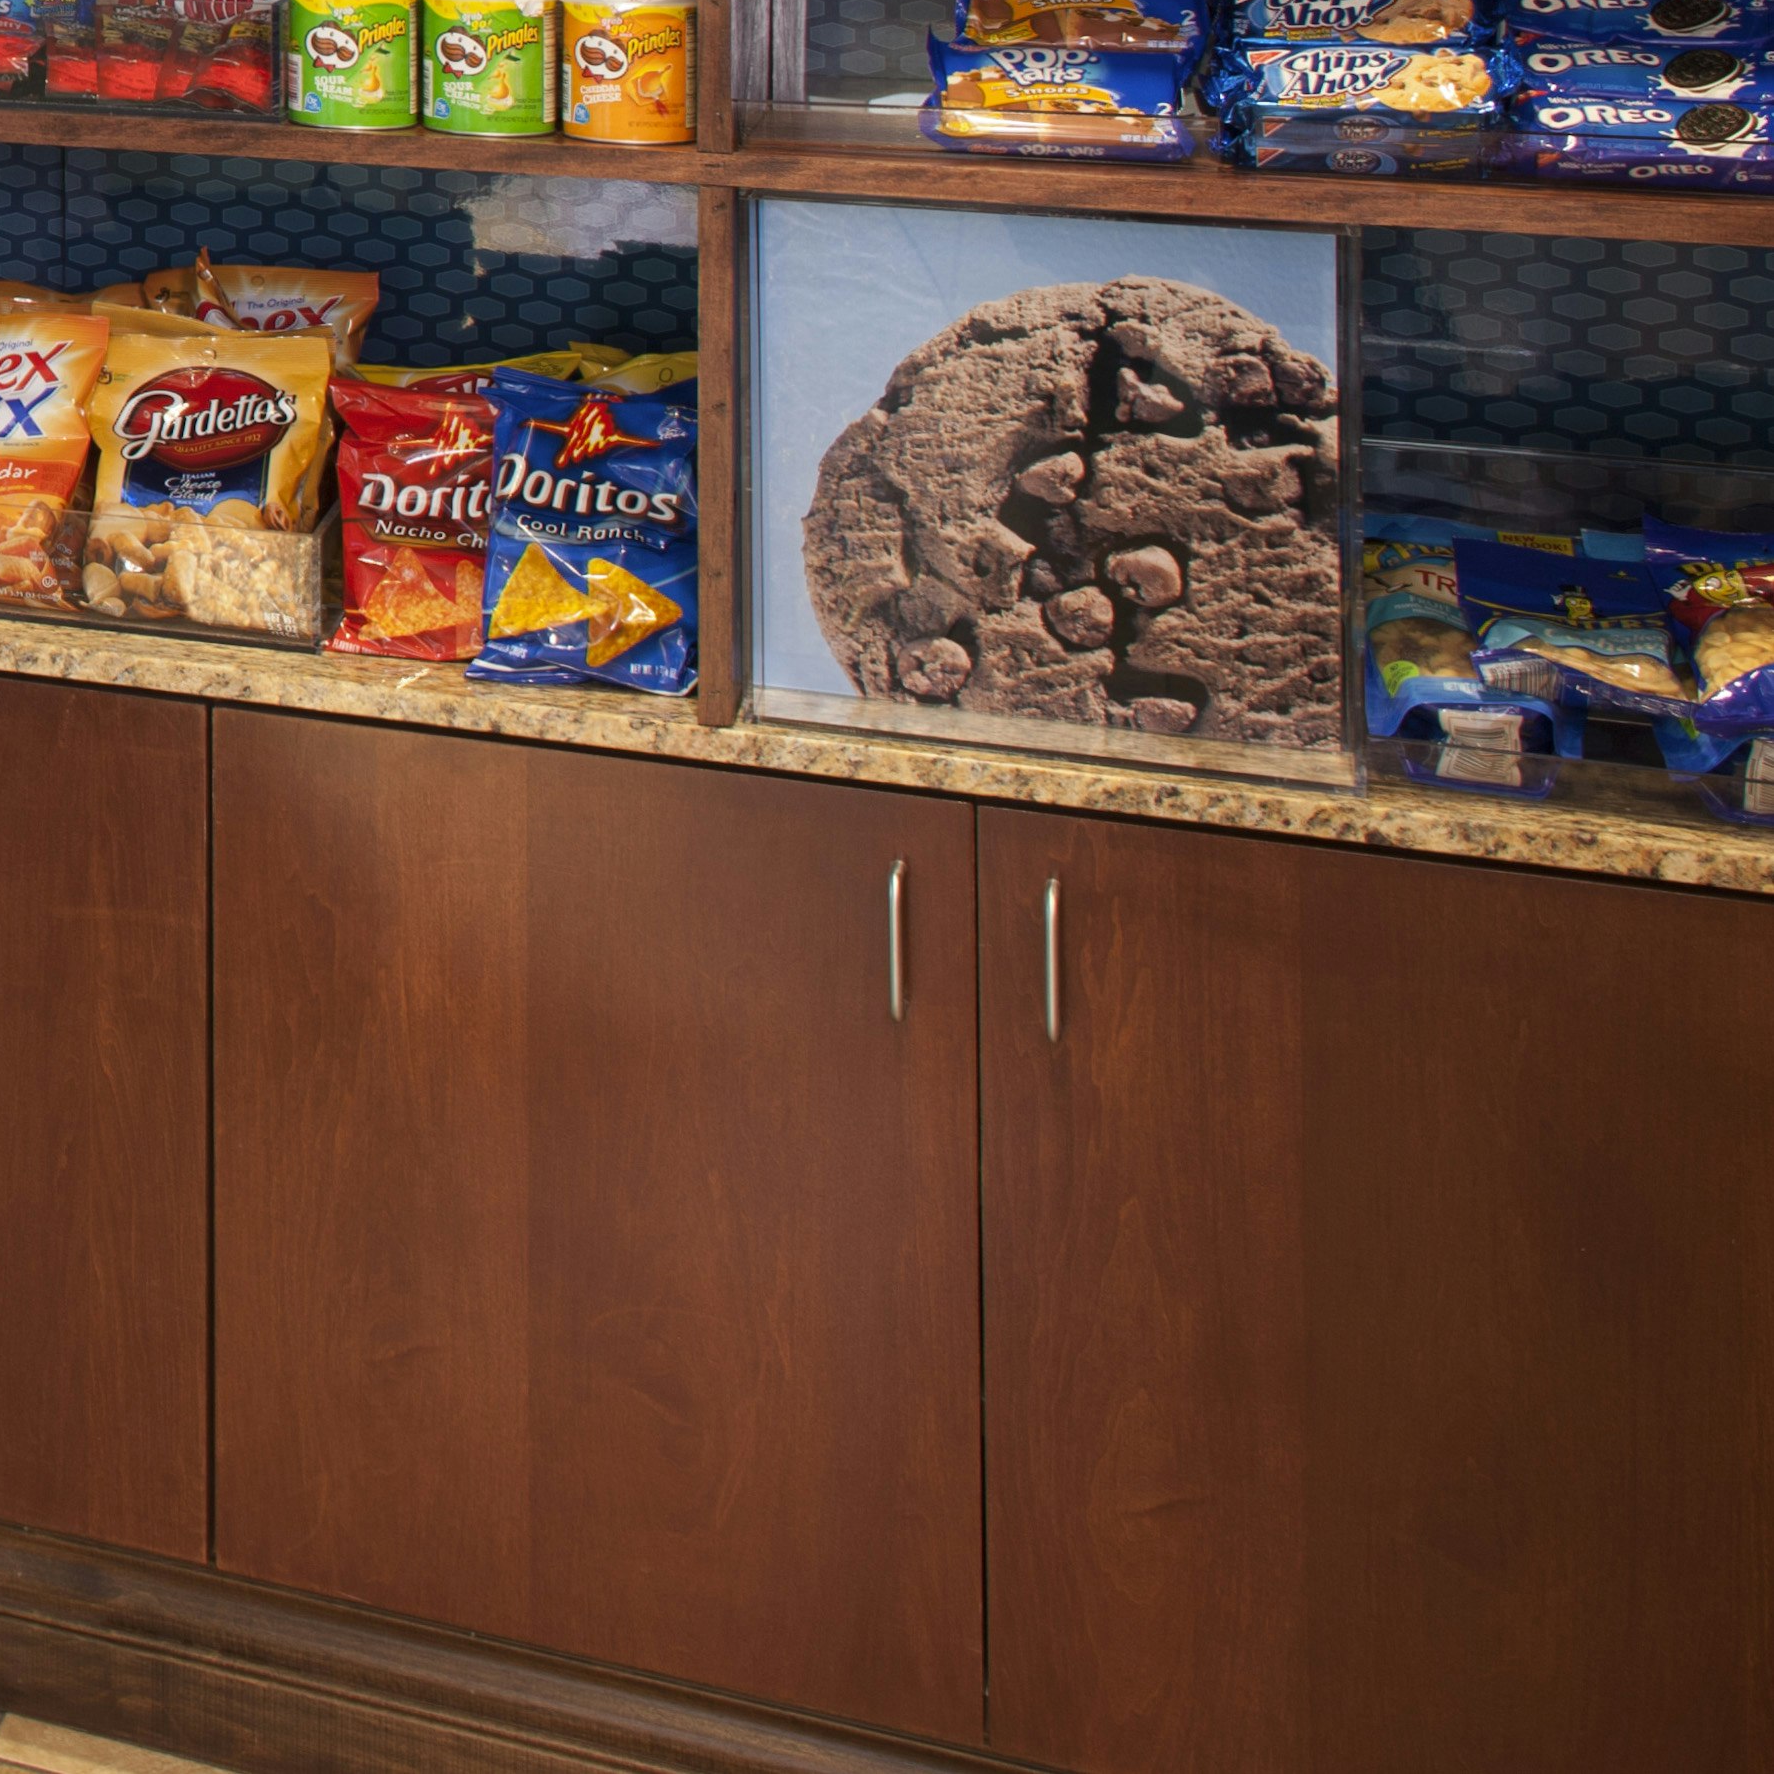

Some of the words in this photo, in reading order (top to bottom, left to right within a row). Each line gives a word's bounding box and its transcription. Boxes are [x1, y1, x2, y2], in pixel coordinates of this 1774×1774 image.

[358, 17, 406, 52] Pringles
[487, 22, 540, 56] Pringles
[626, 29, 681, 62] Pringles
[1282, 51, 1391, 75] Chips
[1527, 48, 1662, 73] OREO
[314, 75, 346, 86] SOUR
[1007, 63, 1085, 84] tarts
[443, 81, 474, 92] SOUR
[579, 84, 622, 94] CHEDDAR
[1006, 86, 1088, 98] S'mores
[582, 92, 622, 103] CHEESE
[1537, 104, 1673, 130] OREO
[246, 299, 265, 310] The
[266, 295, 306, 308] Original
[113, 388, 298, 460] Gardetto's
[174, 440, 212, 453] QUALITY
[214, 437, 243, 448] SINCE
[164, 477, 222, 492] Cheese
[496, 452, 680, 522] Doritos
[375, 519, 447, 541] Nacho
[516, 513, 567, 538] Cool
[576, 525, 646, 543] Ranch
[1502, 533, 1536, 543] NEW
